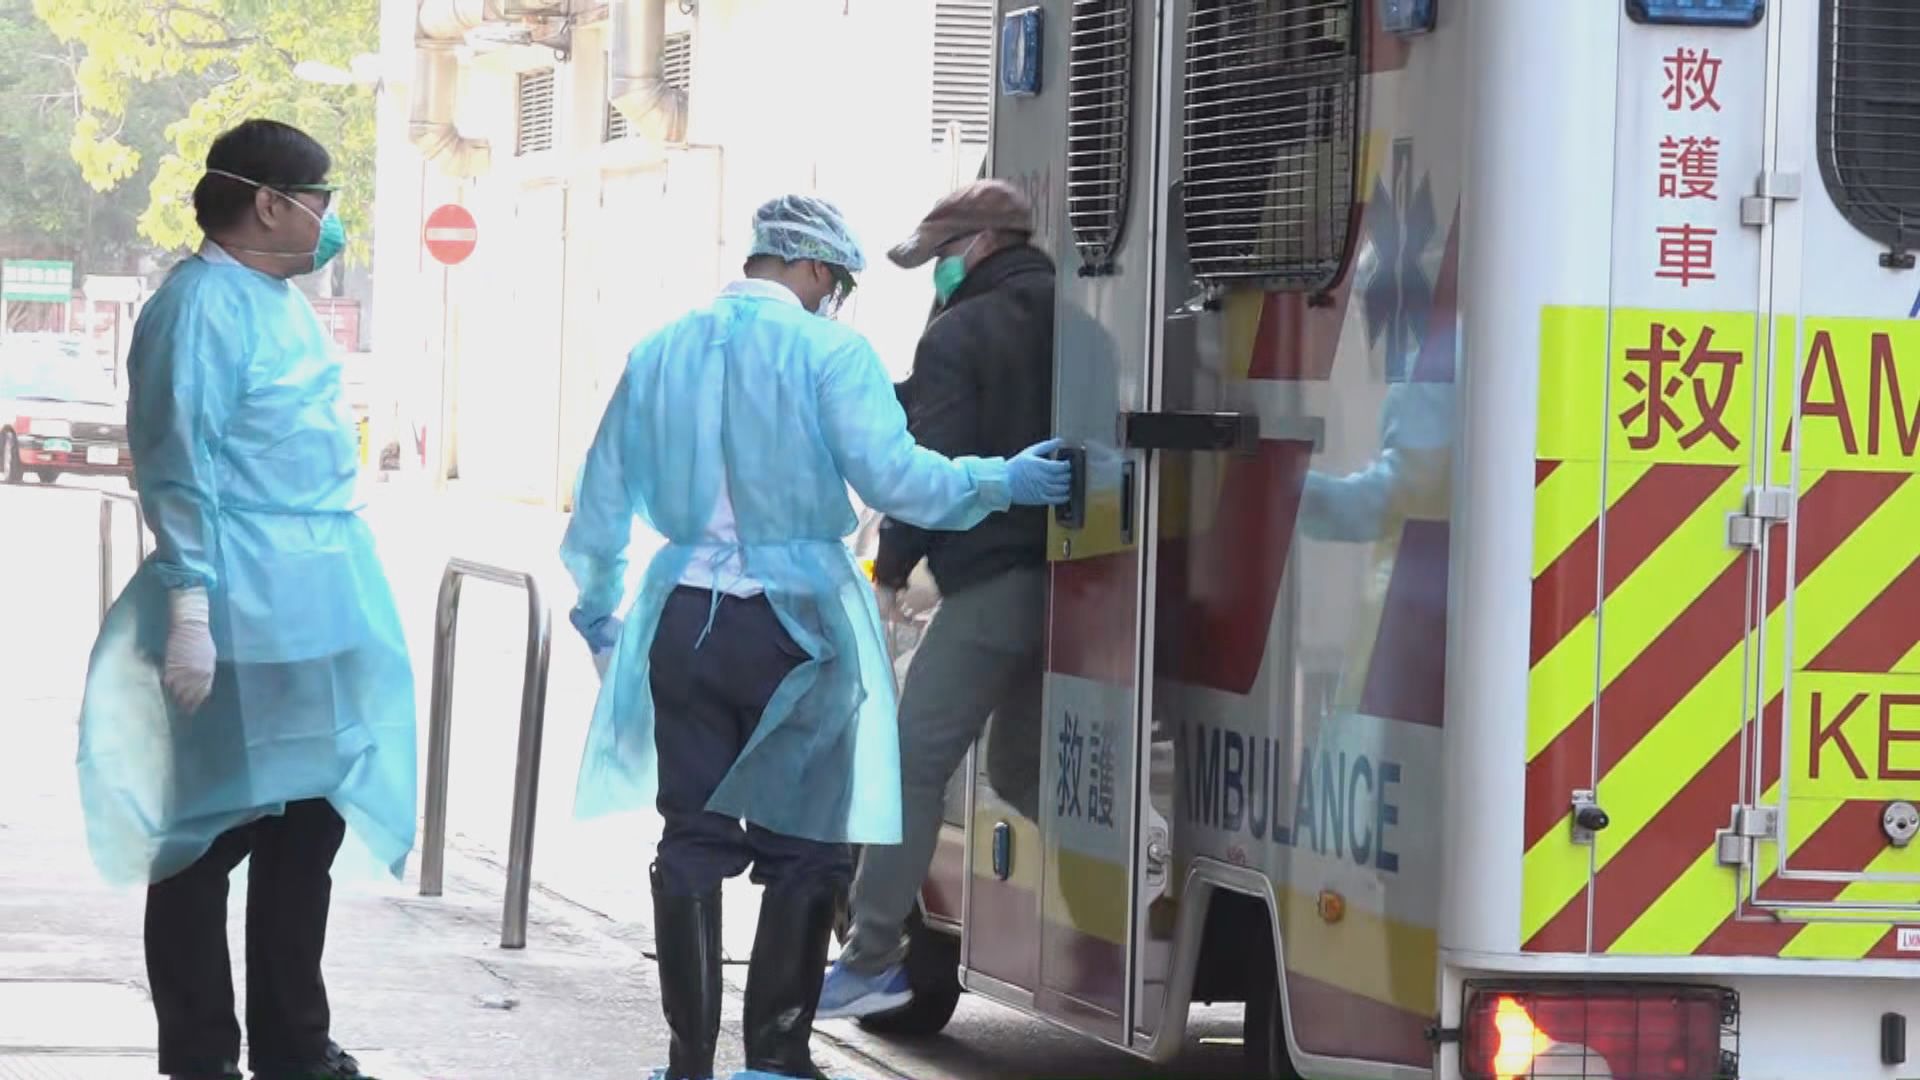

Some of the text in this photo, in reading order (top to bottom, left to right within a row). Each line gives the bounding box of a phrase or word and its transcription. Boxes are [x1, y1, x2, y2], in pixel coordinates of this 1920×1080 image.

[1655, 47, 1722, 287] 救護車
[1618, 322, 1920, 457] 救 AM
[1056, 710, 1115, 828] 救護
[1808, 691, 1920, 780] KE
